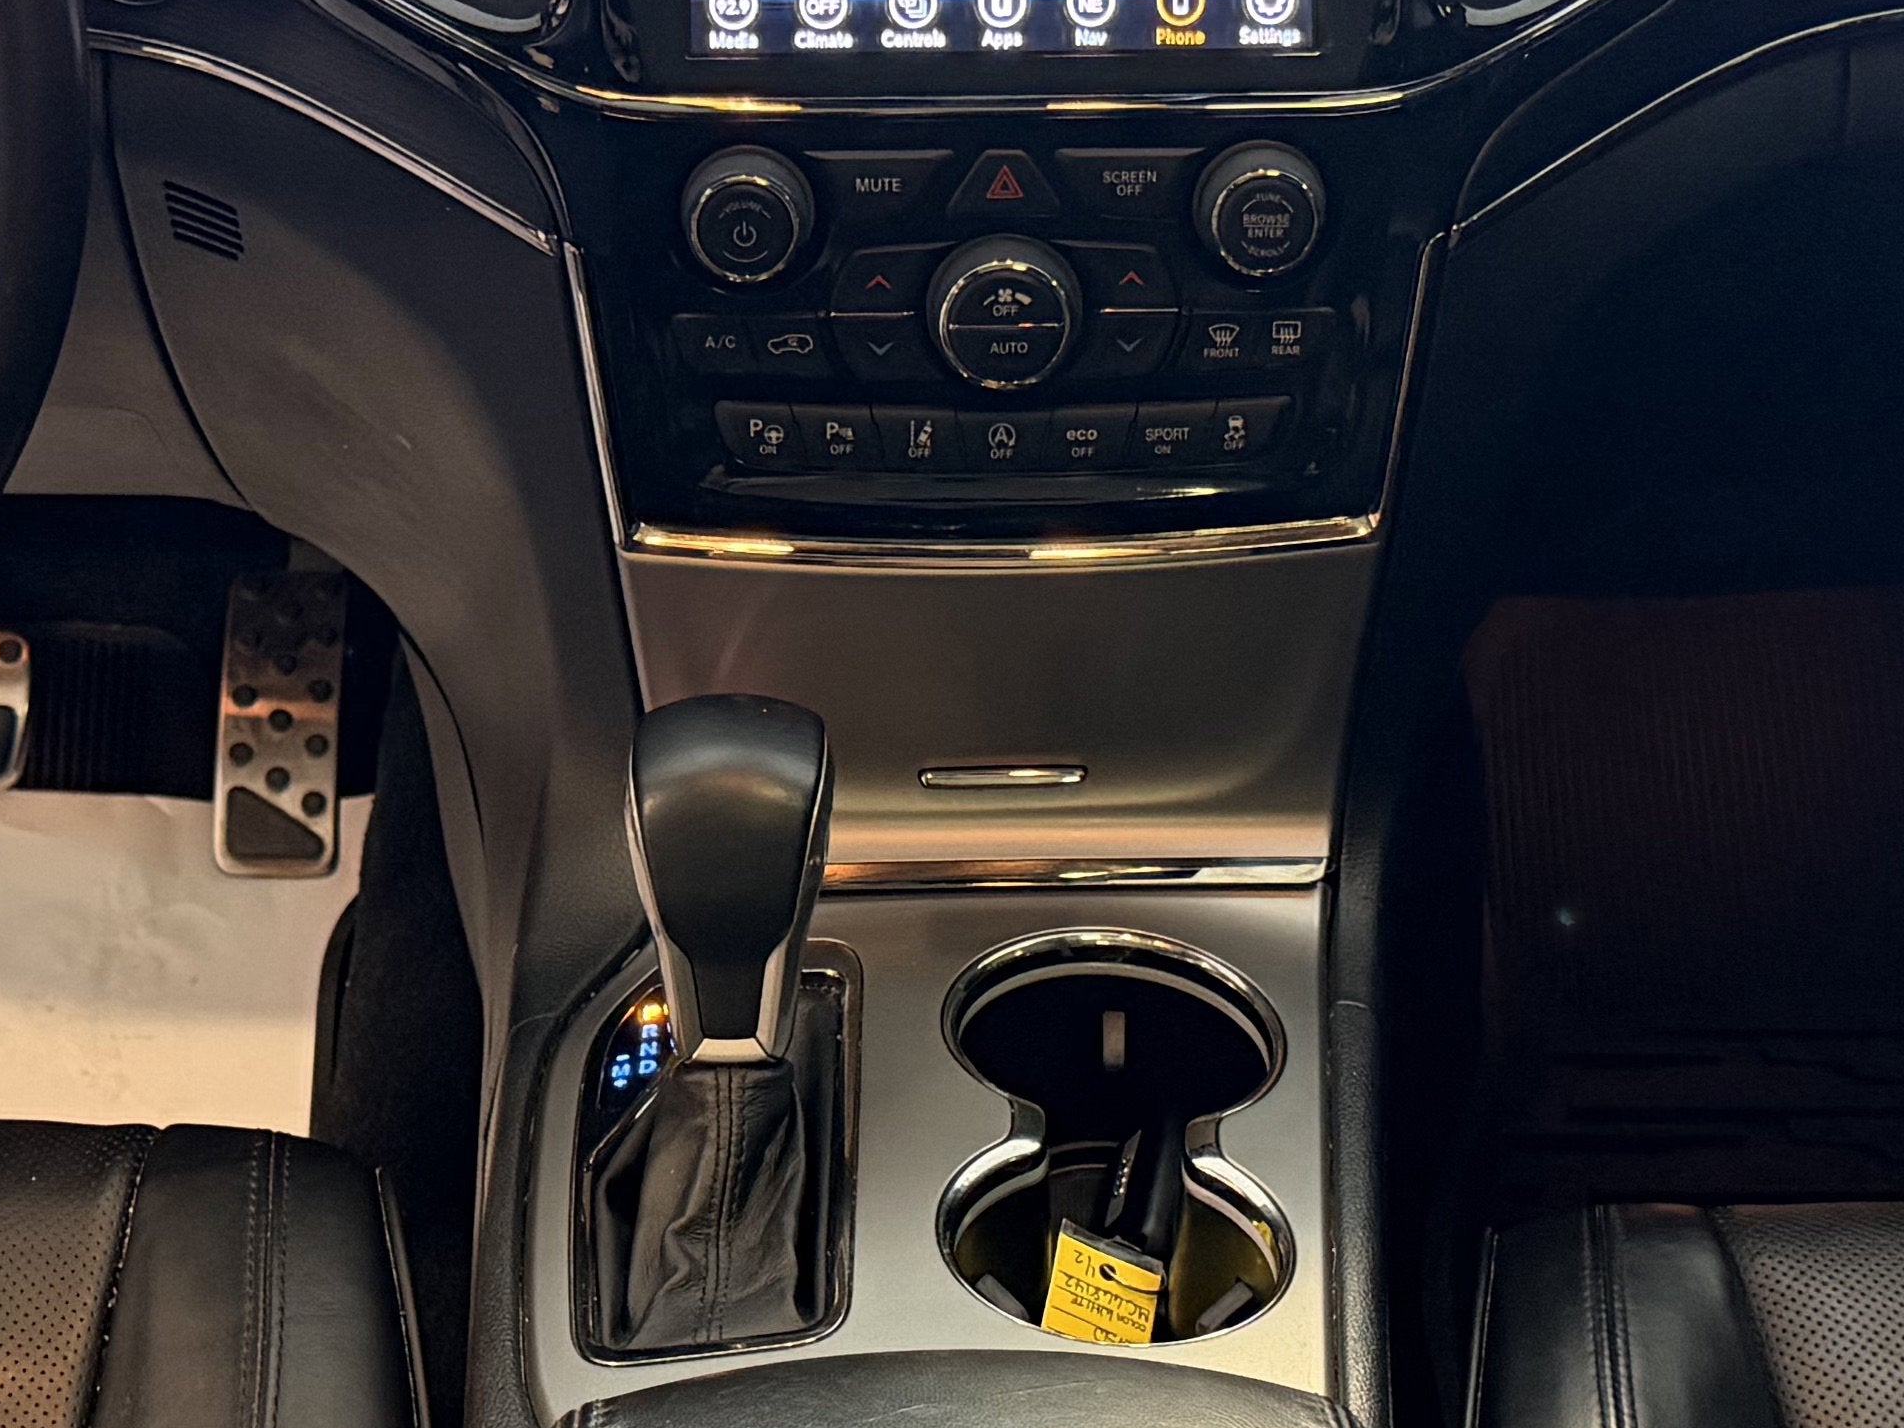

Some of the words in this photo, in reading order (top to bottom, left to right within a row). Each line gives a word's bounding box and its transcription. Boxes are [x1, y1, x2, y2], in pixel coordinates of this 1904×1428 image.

[709, 31, 759, 49] Media
[795, 29, 853, 49] Climate
[881, 29, 946, 49] Controls
[981, 29, 1023, 50] Apps
[1074, 29, 1108, 47] Nav
[1156, 27, 1206, 46] Phone
[1238, 27, 1301, 48] Settings
[1102, 170, 1157, 184] SCREEN
[855, 178, 902, 192] MUTE
[1116, 184, 1143, 197] OFF
[1243, 213, 1290, 225] BROWSE
[1248, 227, 1284, 238] ENTER
[992, 305, 1019, 317] OFF
[705, 335, 736, 349] A/C
[990, 341, 1028, 355] AUTO
[1203, 347, 1240, 358] FRONT
[1271, 344, 1301, 356] REAR
[1066, 429, 1098, 441] eco
[1146, 427, 1190, 441] SPORT
[760, 445, 777, 455] ON
[830, 444, 854, 455] OFF
[908, 447, 931, 458] OFF
[1071, 446, 1095, 458] OFF
[1154, 445, 1171, 455] ON
[1223, 440, 1246, 451] OFF
[990, 448, 1014, 459] OFF
[642, 1024, 658, 1039] R
[640, 1041, 658, 1057] N
[638, 1059, 657, 1074] D
